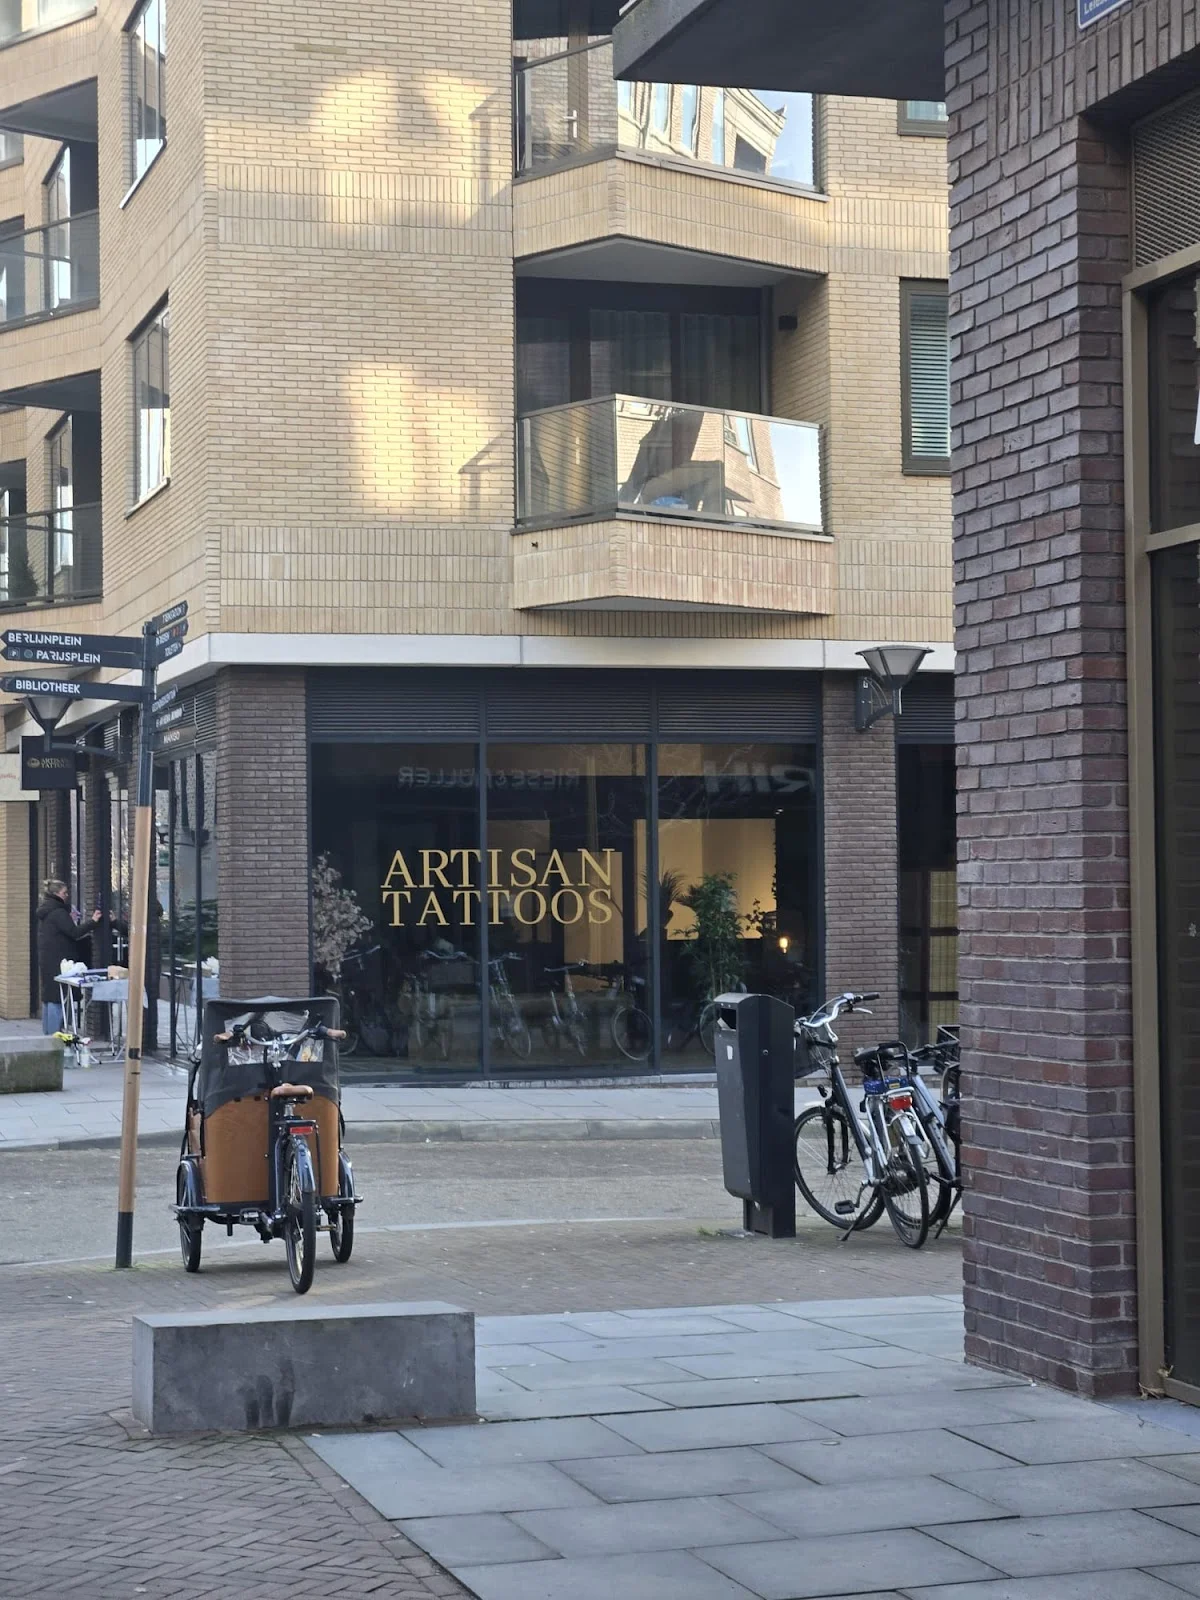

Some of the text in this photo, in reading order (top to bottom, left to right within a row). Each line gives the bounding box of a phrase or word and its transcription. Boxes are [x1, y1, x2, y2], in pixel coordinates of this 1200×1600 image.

[8, 632, 82, 646] BERLIJNPLEIN
[36, 650, 101, 663] PARIJSPLEIN
[15, 680, 81, 694] BIBLIOTHEEK
[380, 848, 615, 888] ARTISAN
[382, 888, 613, 926] TATTOOS
